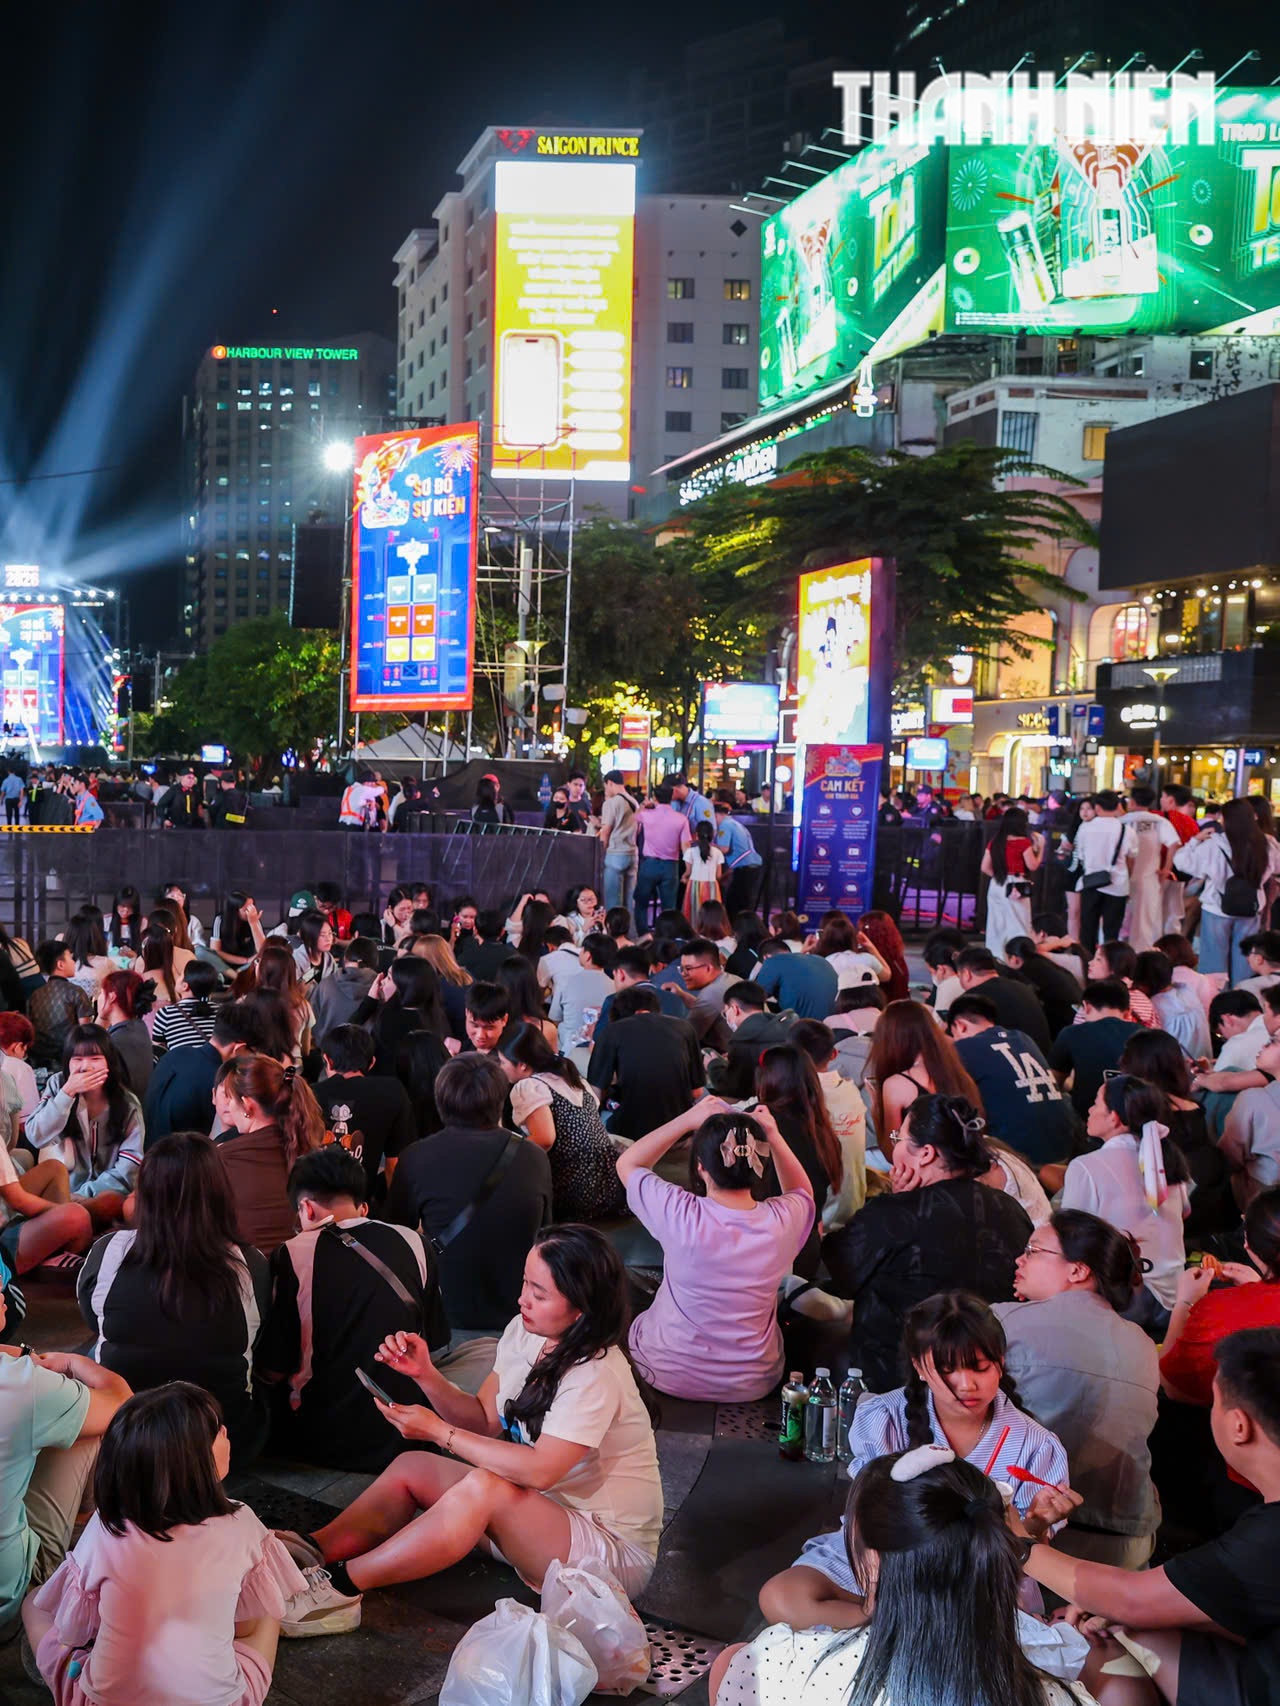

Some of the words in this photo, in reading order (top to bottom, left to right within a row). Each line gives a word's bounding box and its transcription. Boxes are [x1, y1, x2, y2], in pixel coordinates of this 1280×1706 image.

[537, 136, 588, 155] SAIGON
[589, 137, 639, 157] PRINCE
[226, 347, 282, 359] HARBOUR
[284, 347, 314, 360] VIEW
[315, 348, 358, 360] TOWER
[820, 779, 842, 792] CAM
[844, 776, 866, 792] KẾT
[990, 1042, 1062, 1103] LA
